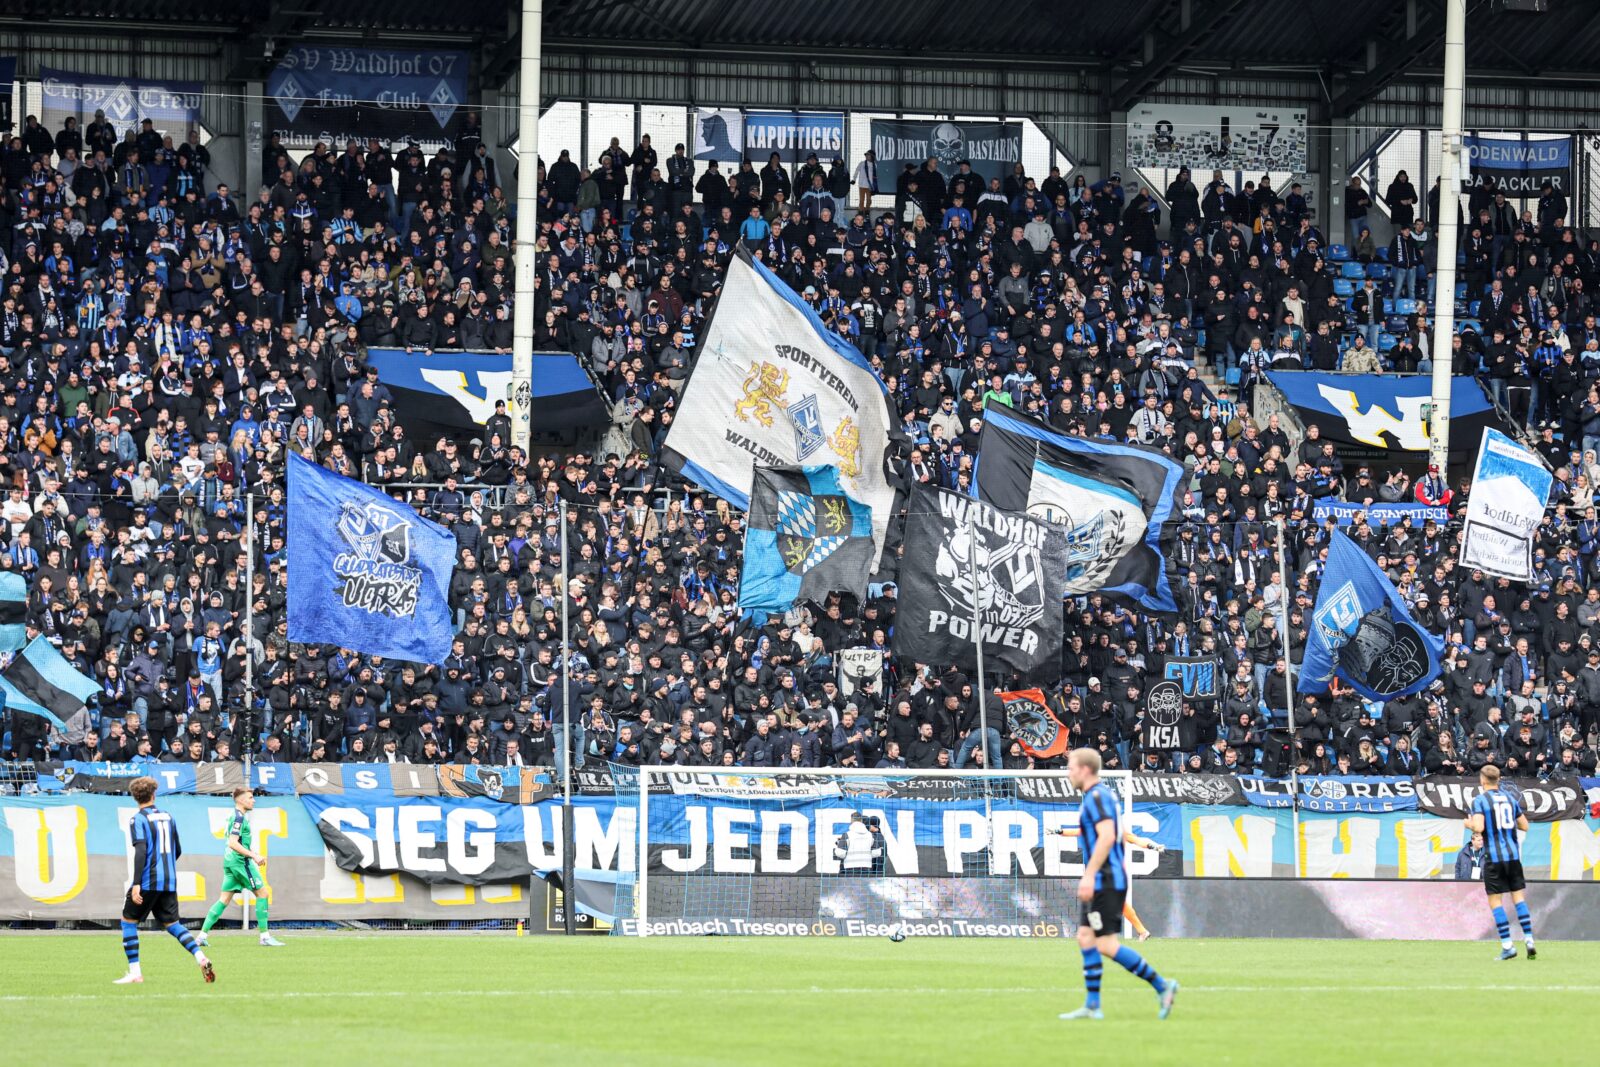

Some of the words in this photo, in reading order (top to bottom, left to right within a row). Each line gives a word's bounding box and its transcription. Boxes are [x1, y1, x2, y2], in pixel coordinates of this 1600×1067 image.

[279, 49, 320, 70] SV
[330, 49, 421, 78] Waldhof
[429, 55, 457, 75] 07
[42, 77, 106, 105] Crazy
[139, 88, 200, 110] Crew
[314, 88, 354, 108] Fan
[376, 91, 421, 110] Club
[273, 129, 314, 145] Blau
[747, 125, 841, 150] KAPUTTICKS
[875, 135, 895, 161] OLD
[897, 139, 928, 160] DIRTY
[968, 137, 1019, 162] BASTARDS
[1470, 145, 1559, 162] ODENWALD
[774, 344, 859, 413] SPORTVEREIN
[726, 428, 792, 466] WALDHO
[939, 491, 1048, 549] WALDHOF
[343, 576, 418, 617] ULTRAS
[929, 610, 1039, 655] POWER
[845, 652, 877, 662] ULTRA
[1149, 725, 1180, 748] KSA
[1493, 802, 1515, 829] 10
[157, 821, 171, 854] 11
[319, 806, 497, 874] SIEG
[522, 805, 637, 872] UM
[662, 806, 919, 875] JEDEN
[942, 810, 1160, 876] PRES
[622, 919, 726, 936] Esenbach
[730, 919, 837, 936] Tresore.de
[954, 921, 1058, 937] Tresore.de
